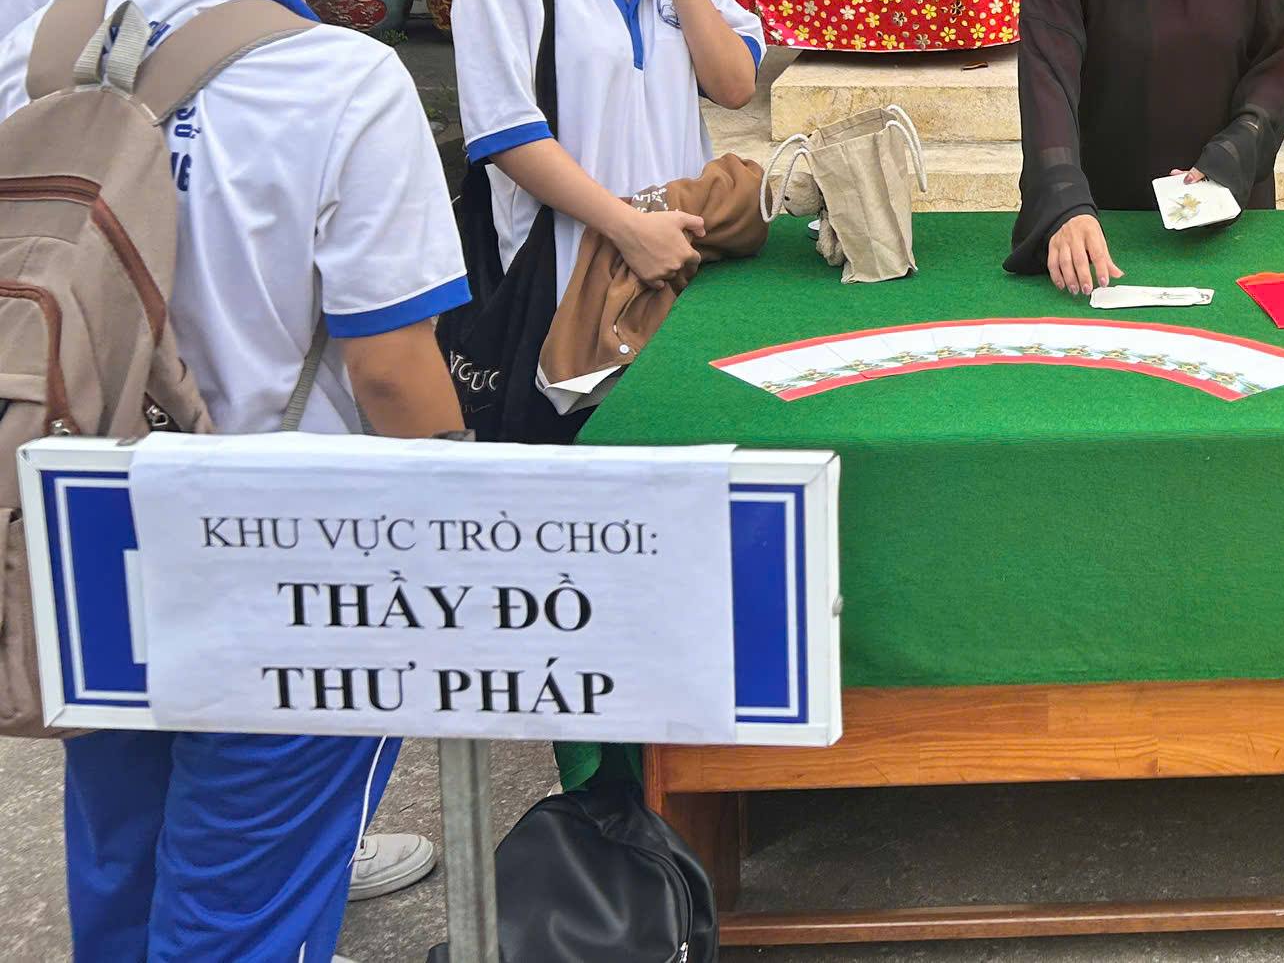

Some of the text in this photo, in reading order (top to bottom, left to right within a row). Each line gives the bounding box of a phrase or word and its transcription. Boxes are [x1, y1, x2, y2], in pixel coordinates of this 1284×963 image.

[201, 510, 659, 557] KHU VỰC TRÒ CHƠI:
[277, 569, 593, 634] THẦY ĐỒ
[262, 655, 614, 716] THƯ PHÁP
